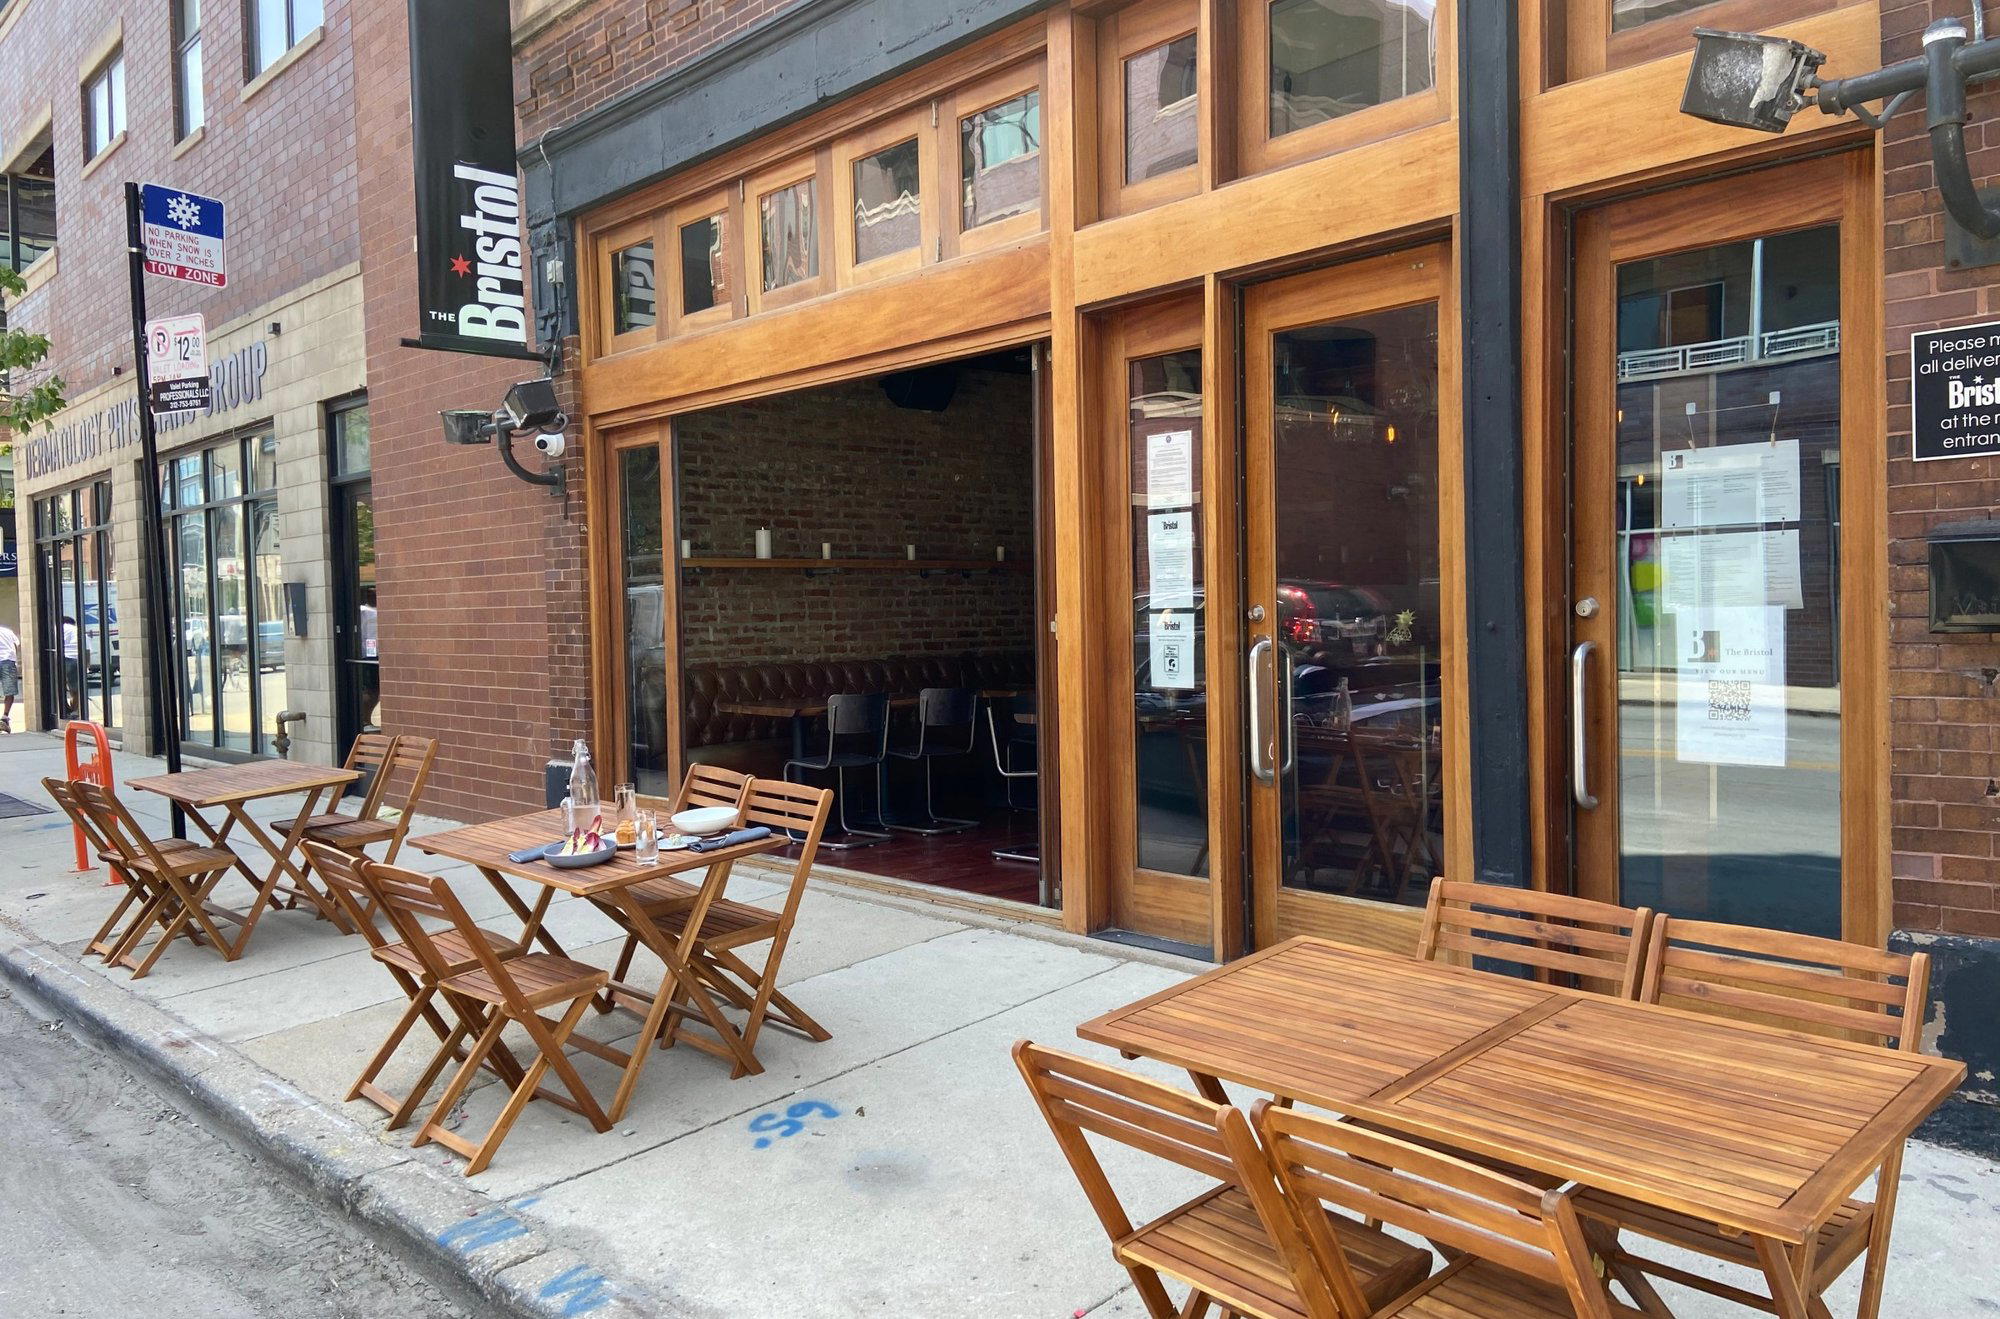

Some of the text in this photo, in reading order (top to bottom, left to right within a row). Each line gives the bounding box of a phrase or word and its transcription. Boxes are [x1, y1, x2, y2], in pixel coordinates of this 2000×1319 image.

[149, 227, 199, 245] NO PARKING
[149, 238, 212, 258] WHEN SNOW IS
[453, 164, 527, 343] Bristol
[149, 248, 215, 268] OVER 2 INCHES
[149, 261, 220, 285] TOW ZONE
[429, 311, 456, 323] THE
[1929, 337, 1986, 354] Please
[1920, 354, 2000, 375] all deliver
[170, 381, 199, 390] Valet Parking
[1948, 376, 2000, 409] Brist
[160, 388, 209, 401] PROFESSIONALS LLC
[1940, 414, 1959, 429] at
[1963, 413, 1991, 427] the
[25, 411, 102, 480] DERMATOLOGY
[1943, 433, 2000, 449] entran
[1726, 648, 1773, 657] The Bristol
[1740, 668, 1765, 676] MENU
